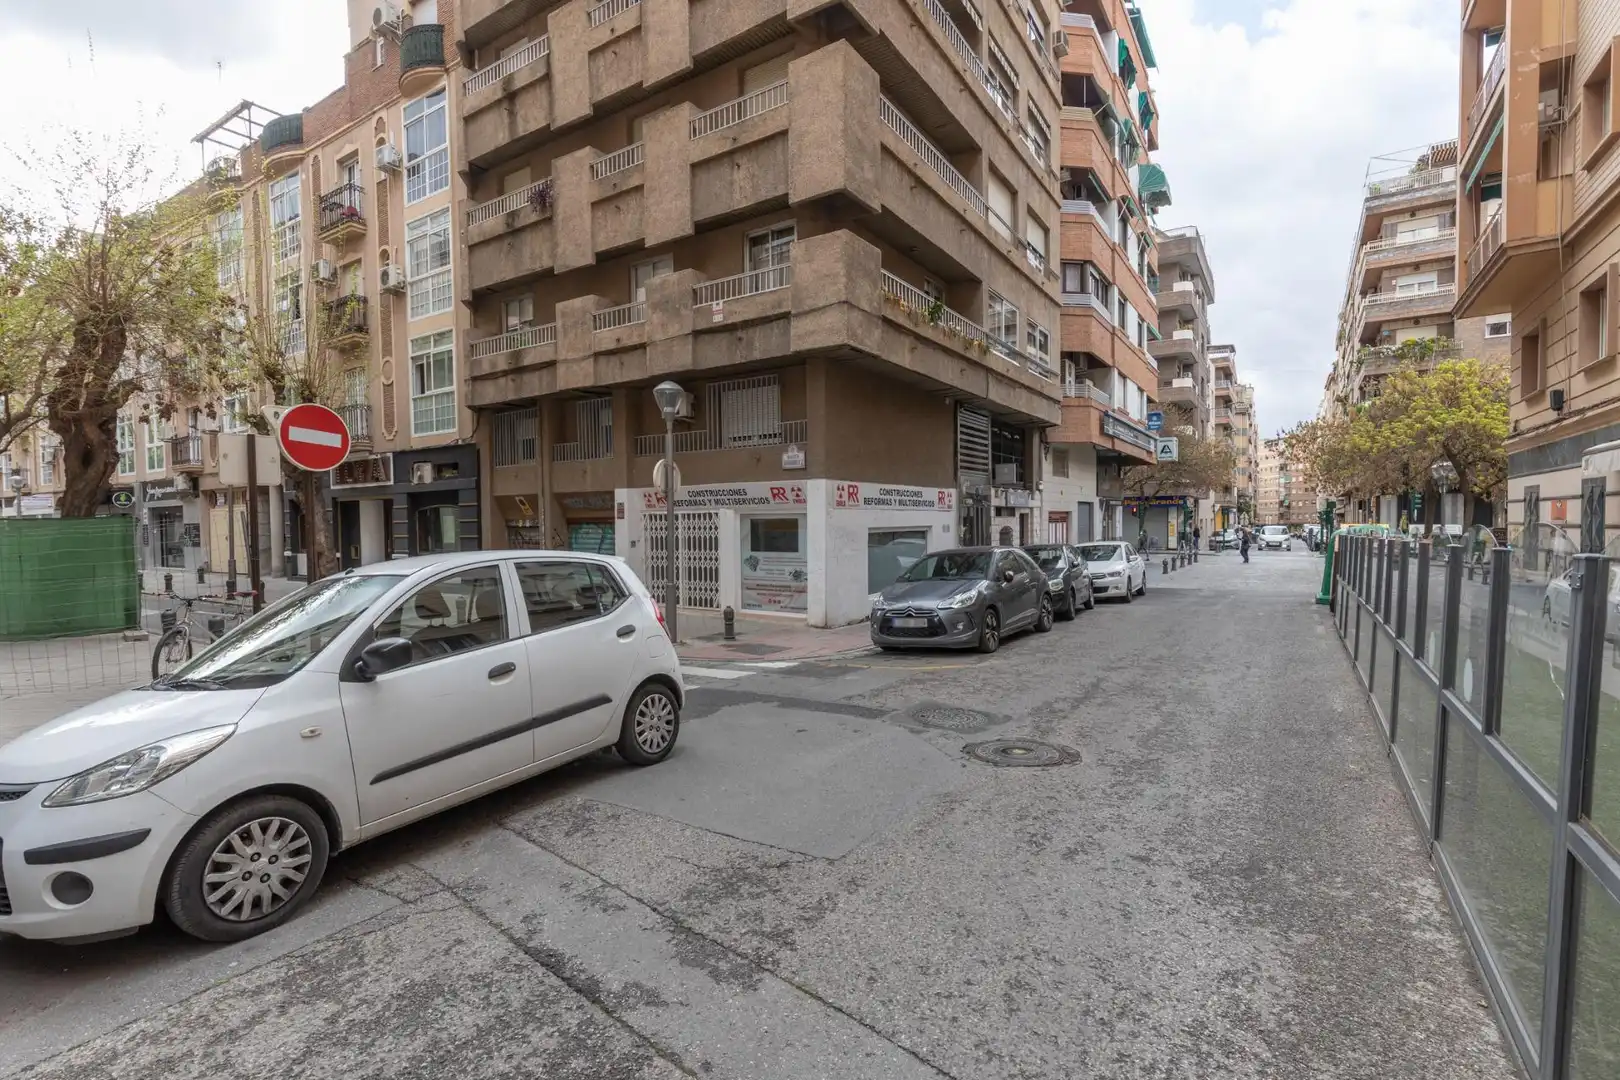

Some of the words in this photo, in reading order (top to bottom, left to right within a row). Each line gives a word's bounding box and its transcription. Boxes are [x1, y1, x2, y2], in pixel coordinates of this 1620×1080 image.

[687, 488, 748, 498] CONSTRUCCIONES
[770, 486, 789, 503] RR
[847, 484, 860, 504] RR
[879, 488, 924, 499] CONSTRUCCIONES
[673, 498, 707, 507] REFORMAS
[708, 498, 713, 506] Y
[714, 496, 771, 506] MULTISERVICIOS
[863, 497, 893, 507] REFORMAS
[893, 498, 898, 507] Y
[898, 499, 936, 508] MULTISERVICIOS
